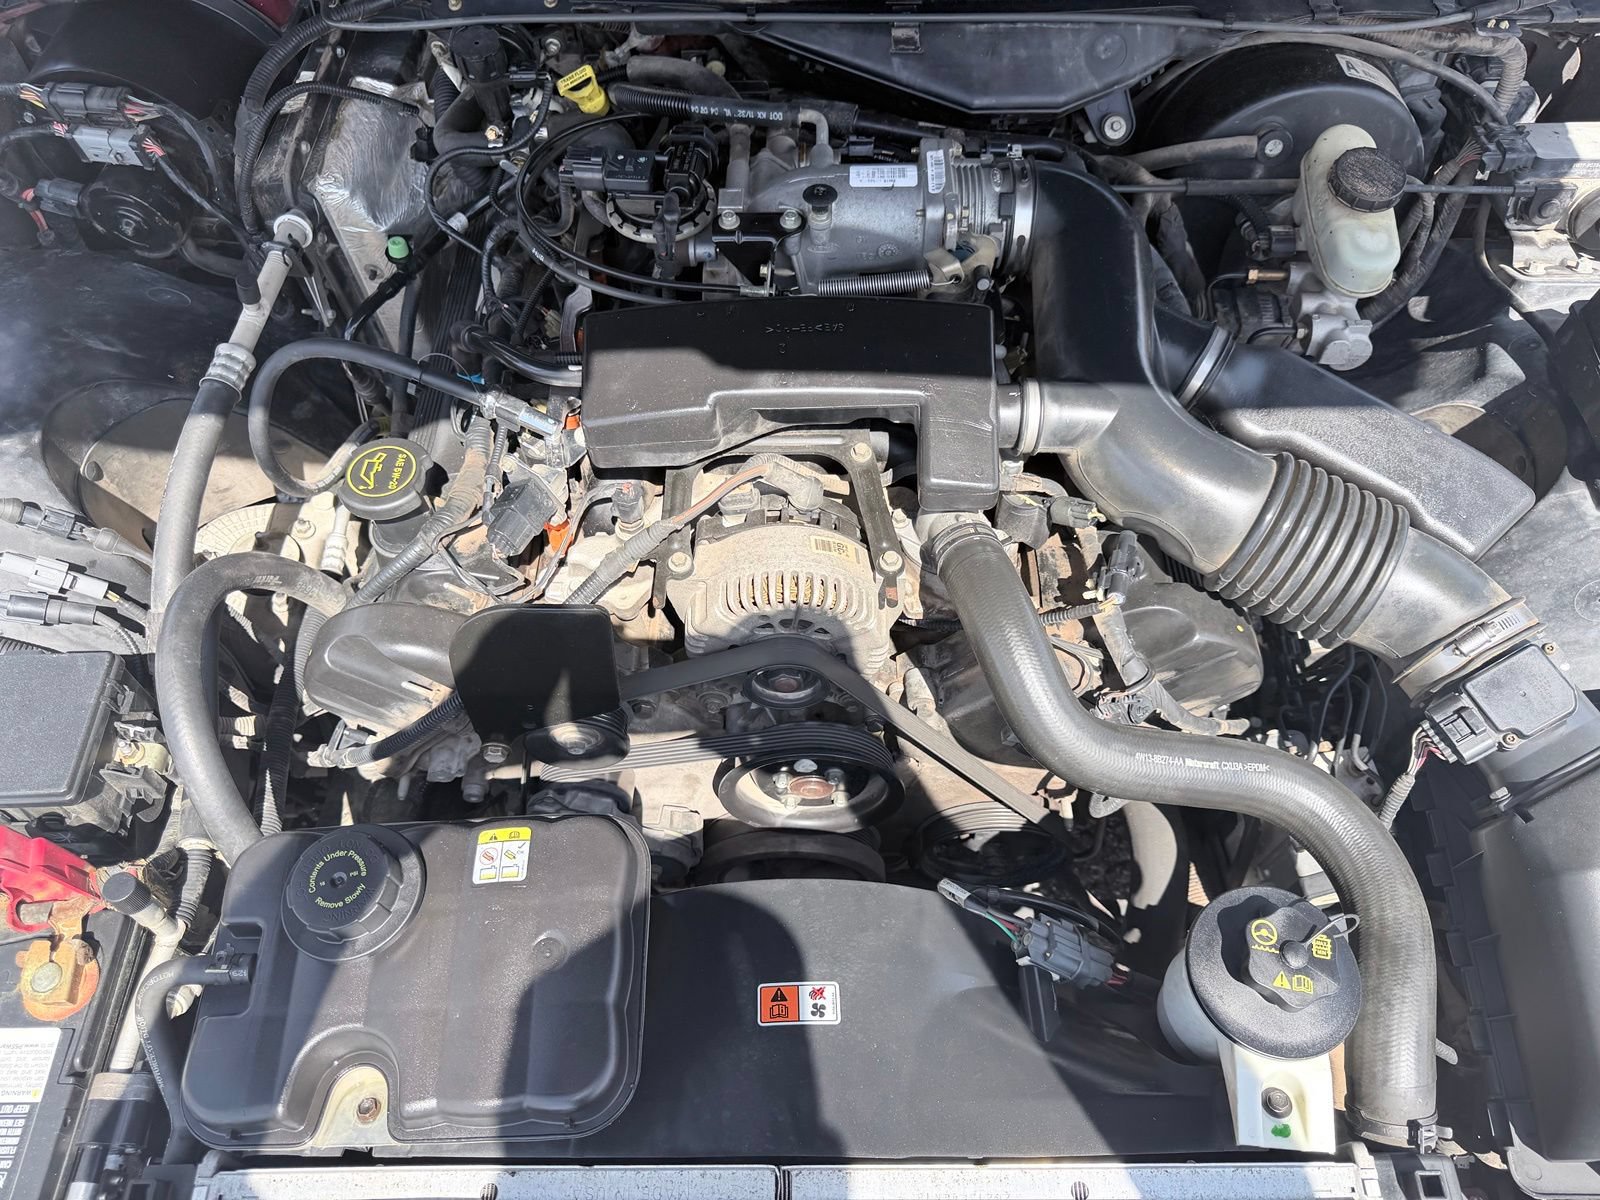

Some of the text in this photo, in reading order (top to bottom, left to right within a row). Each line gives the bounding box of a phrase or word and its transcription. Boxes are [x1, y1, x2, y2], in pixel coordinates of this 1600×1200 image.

[769, 112, 783, 121] DOT
[388, 453, 408, 489] SAE 5W-20
[308, 850, 367, 893] Contents Under Pressure
[315, 883, 366, 909] Remove Slowly
[13, 1104, 30, 1113] KEEP
